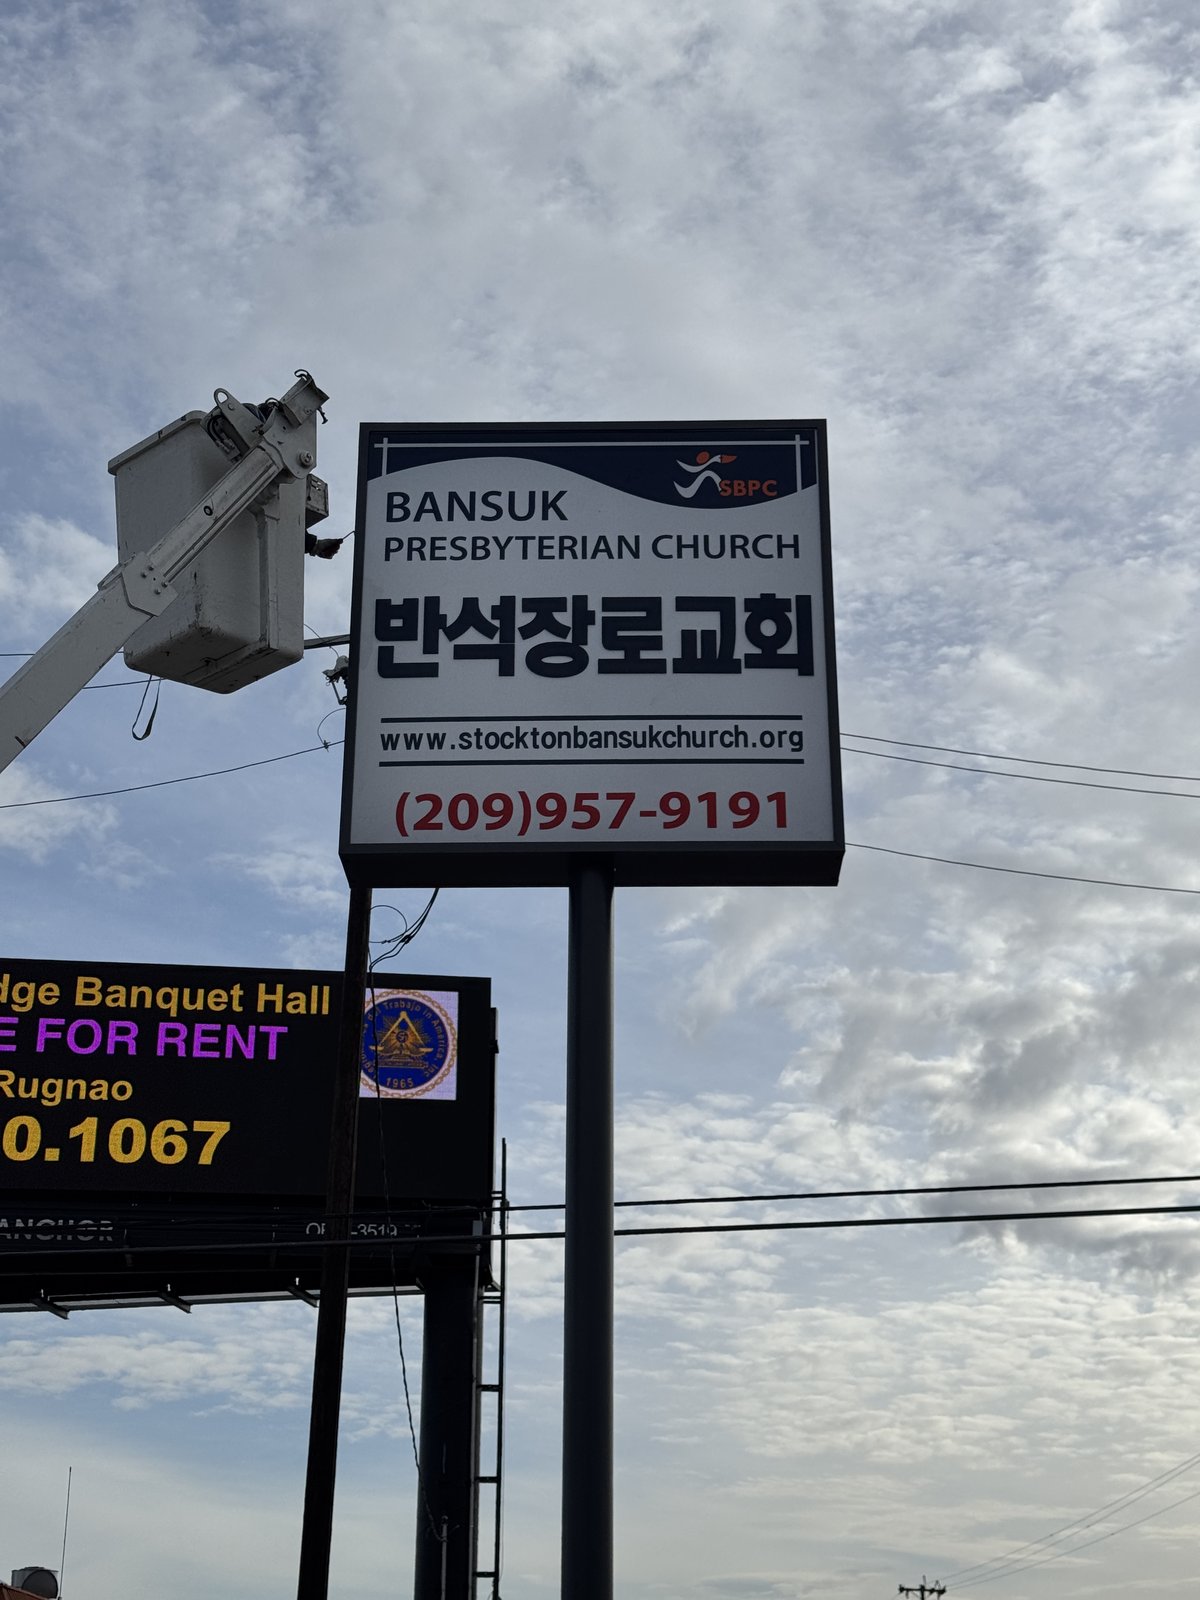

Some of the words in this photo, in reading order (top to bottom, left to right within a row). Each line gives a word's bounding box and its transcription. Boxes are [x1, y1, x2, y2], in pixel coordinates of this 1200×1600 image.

[386, 490, 569, 523] BANSUK
[719, 480, 777, 497] SBPC
[384, 534, 642, 562] PRESBYTERIAN
[651, 533, 800, 560] CHURCH
[374, 592, 815, 679] 반석장로교회
[380, 725, 804, 752] www.stocktonbansukchurch.org
[395, 791, 788, 836] (209)957-9191
[75, 976, 244, 1017] Banquet
[256, 983, 330, 1015] Hall
[36, 1017, 139, 1056] FOR
[156, 1021, 289, 1061] RENT
[386, 1077, 414, 1089] 1965
[2, 1115, 231, 1165] 0.1067
